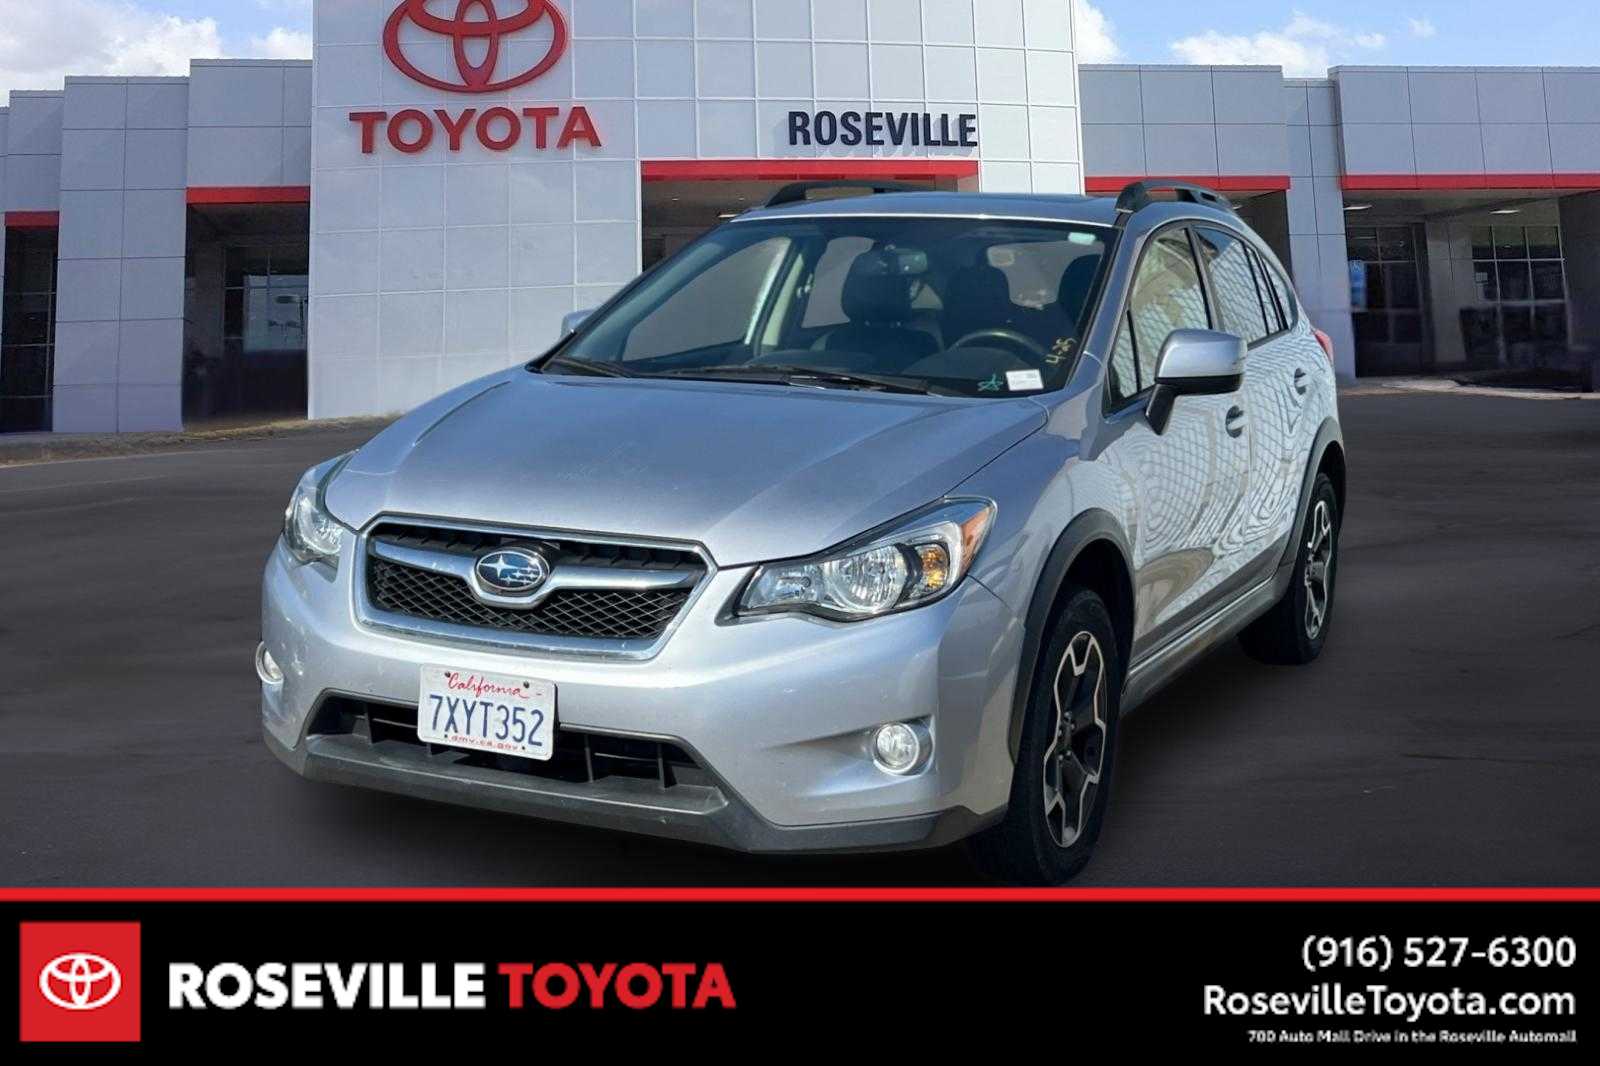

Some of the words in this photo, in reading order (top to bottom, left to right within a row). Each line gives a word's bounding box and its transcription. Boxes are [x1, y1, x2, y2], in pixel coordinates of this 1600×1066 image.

[349, 106, 602, 153] TOYOTA
[788, 111, 978, 147] ROSEVILLE
[447, 671, 528, 698] California
[429, 694, 543, 747] 7XYT352
